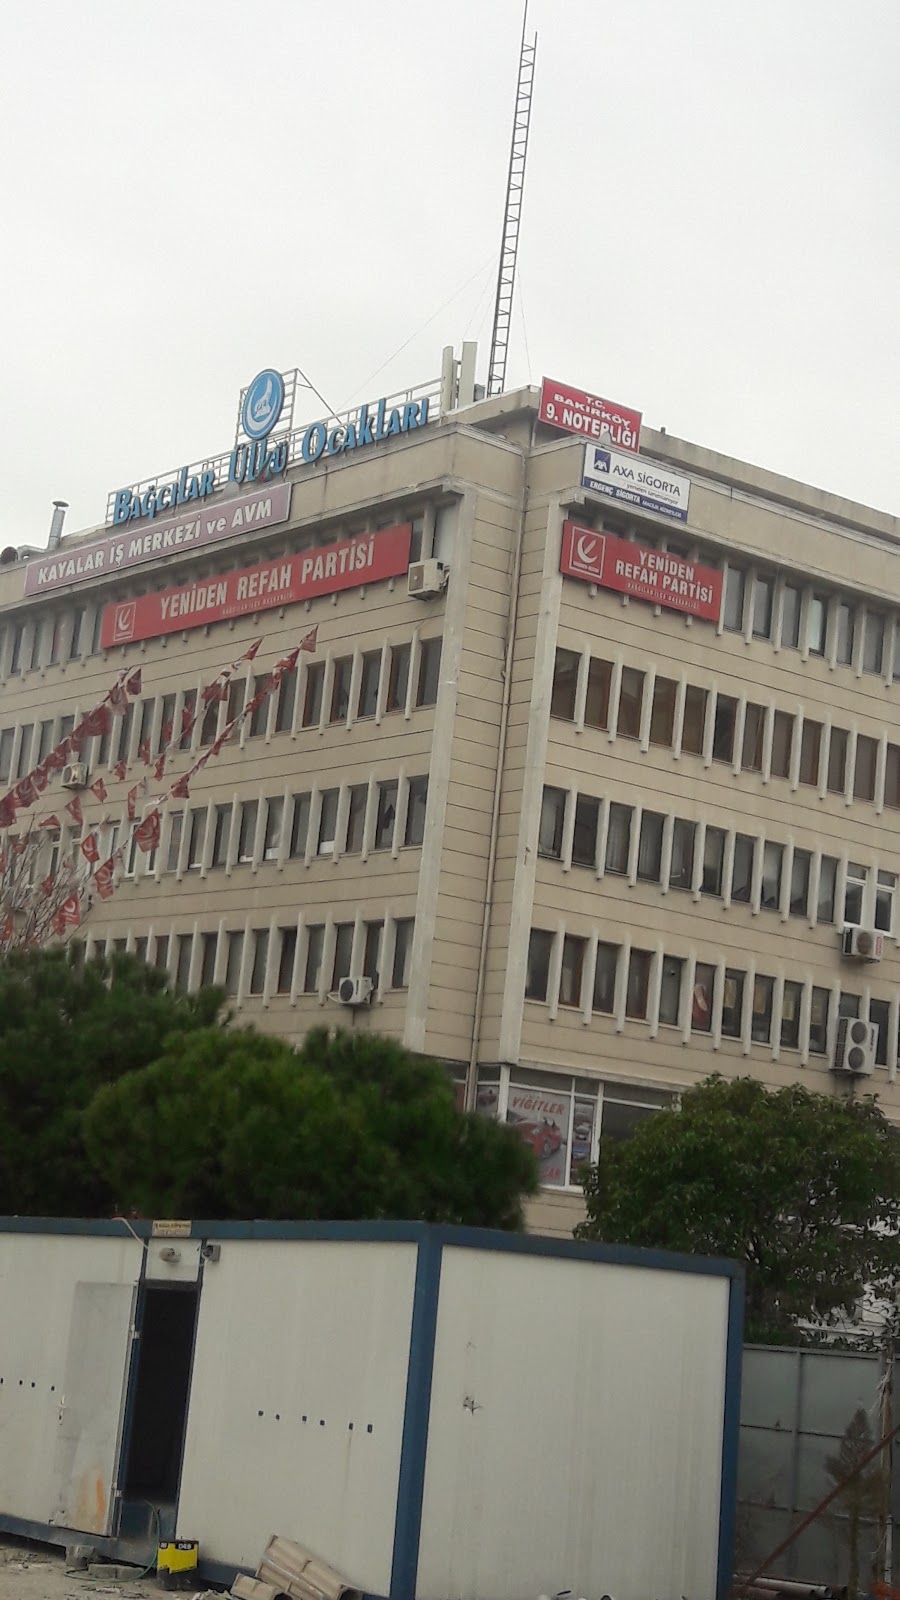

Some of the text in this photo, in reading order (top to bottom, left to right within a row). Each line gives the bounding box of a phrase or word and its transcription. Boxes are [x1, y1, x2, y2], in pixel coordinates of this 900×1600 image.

[546, 402, 637, 449] 9. NOTERLİĞİ
[554, 393, 632, 427] BAKIRKÖY
[589, 480, 614, 496] ERGENÇ
[612, 464, 682, 497] AXA SİGORTA
[37, 497, 273, 586] KAYALAR İŞ MERKEZİ ve AVM
[160, 535, 376, 621] YENİDEN REFAH PARTİSİ
[615, 559, 658, 587] REFAH
[662, 575, 714, 604] PARTİSİ
[640, 549, 695, 581] YENİDEN
